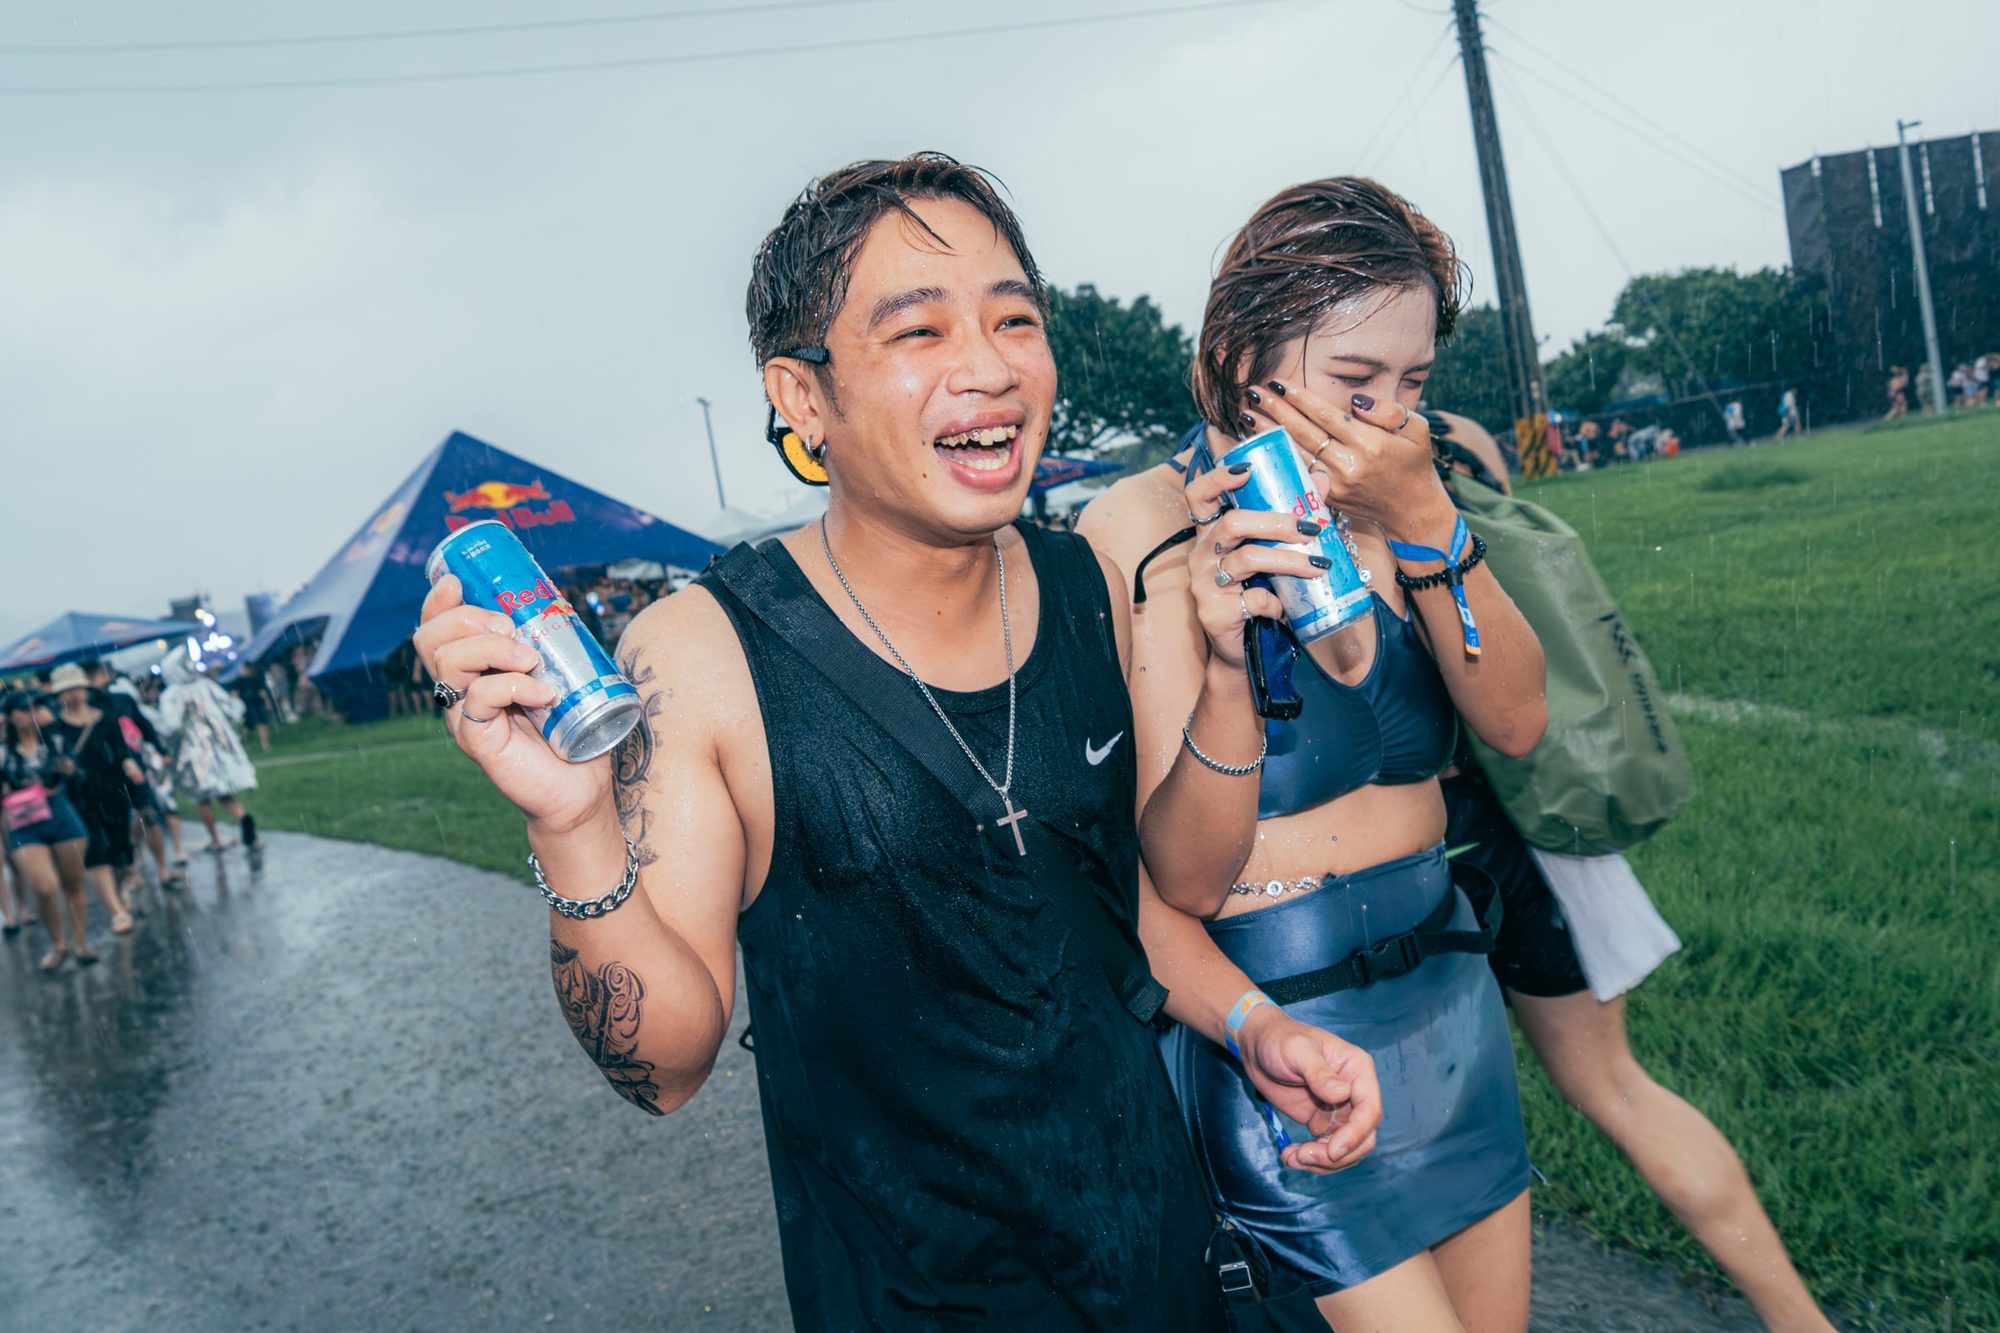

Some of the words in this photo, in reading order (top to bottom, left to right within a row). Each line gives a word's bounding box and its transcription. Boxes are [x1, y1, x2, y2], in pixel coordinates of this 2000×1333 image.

[444, 509, 515, 534] Rd
[509, 500, 576, 528] Bull
[496, 578, 553, 616] Red
